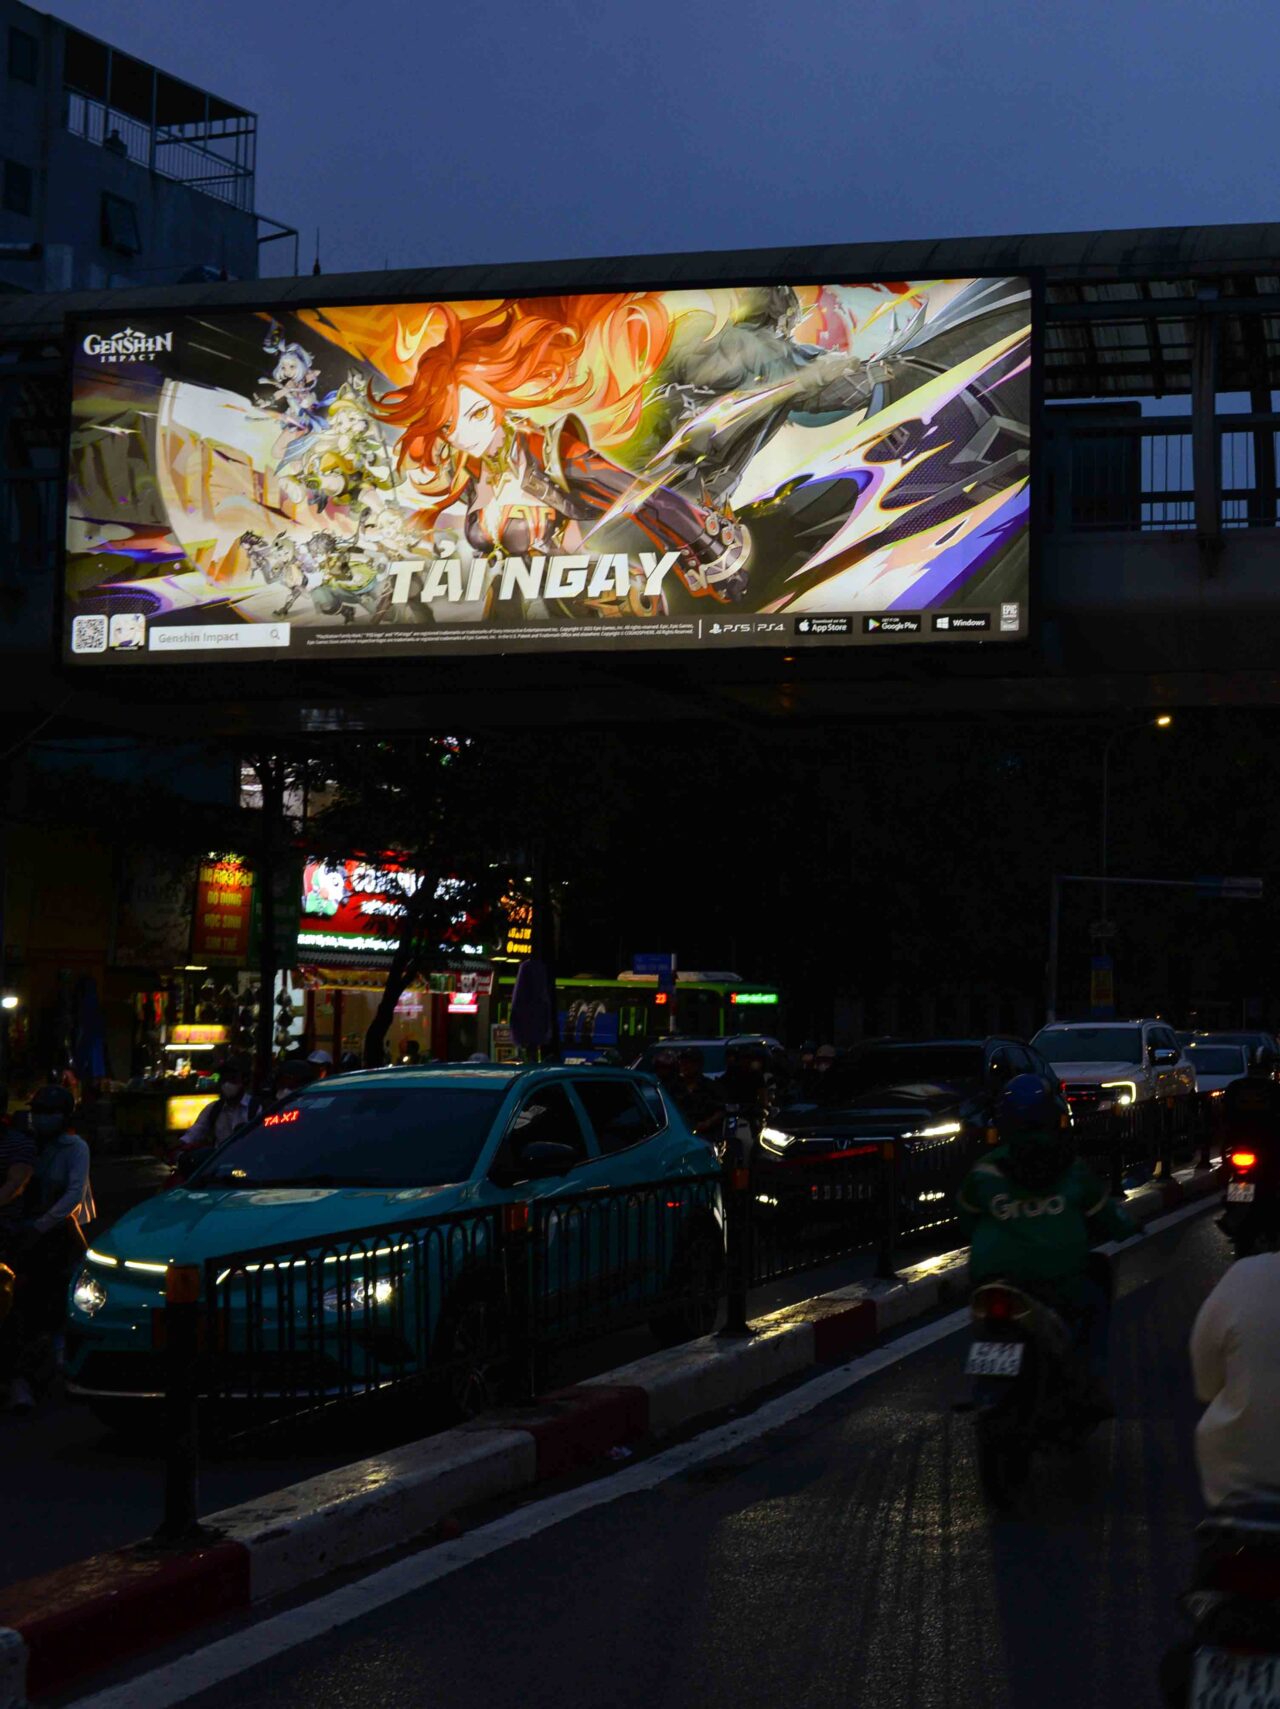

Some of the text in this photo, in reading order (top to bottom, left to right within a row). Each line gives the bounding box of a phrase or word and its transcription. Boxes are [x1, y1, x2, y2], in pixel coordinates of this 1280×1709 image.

[83, 331, 173, 355] GENSHIN
[100, 353, 155, 363] IMPACT
[388, 540, 681, 604] TẢI NGAY
[723, 623, 785, 632] PS5 PS4
[812, 623, 847, 633] App Store
[882, 622, 918, 632] Google Play
[953, 619, 986, 627] Windows
[158, 632, 239, 644] Genshin Impact
[263, 1110, 300, 1127] TAXI
